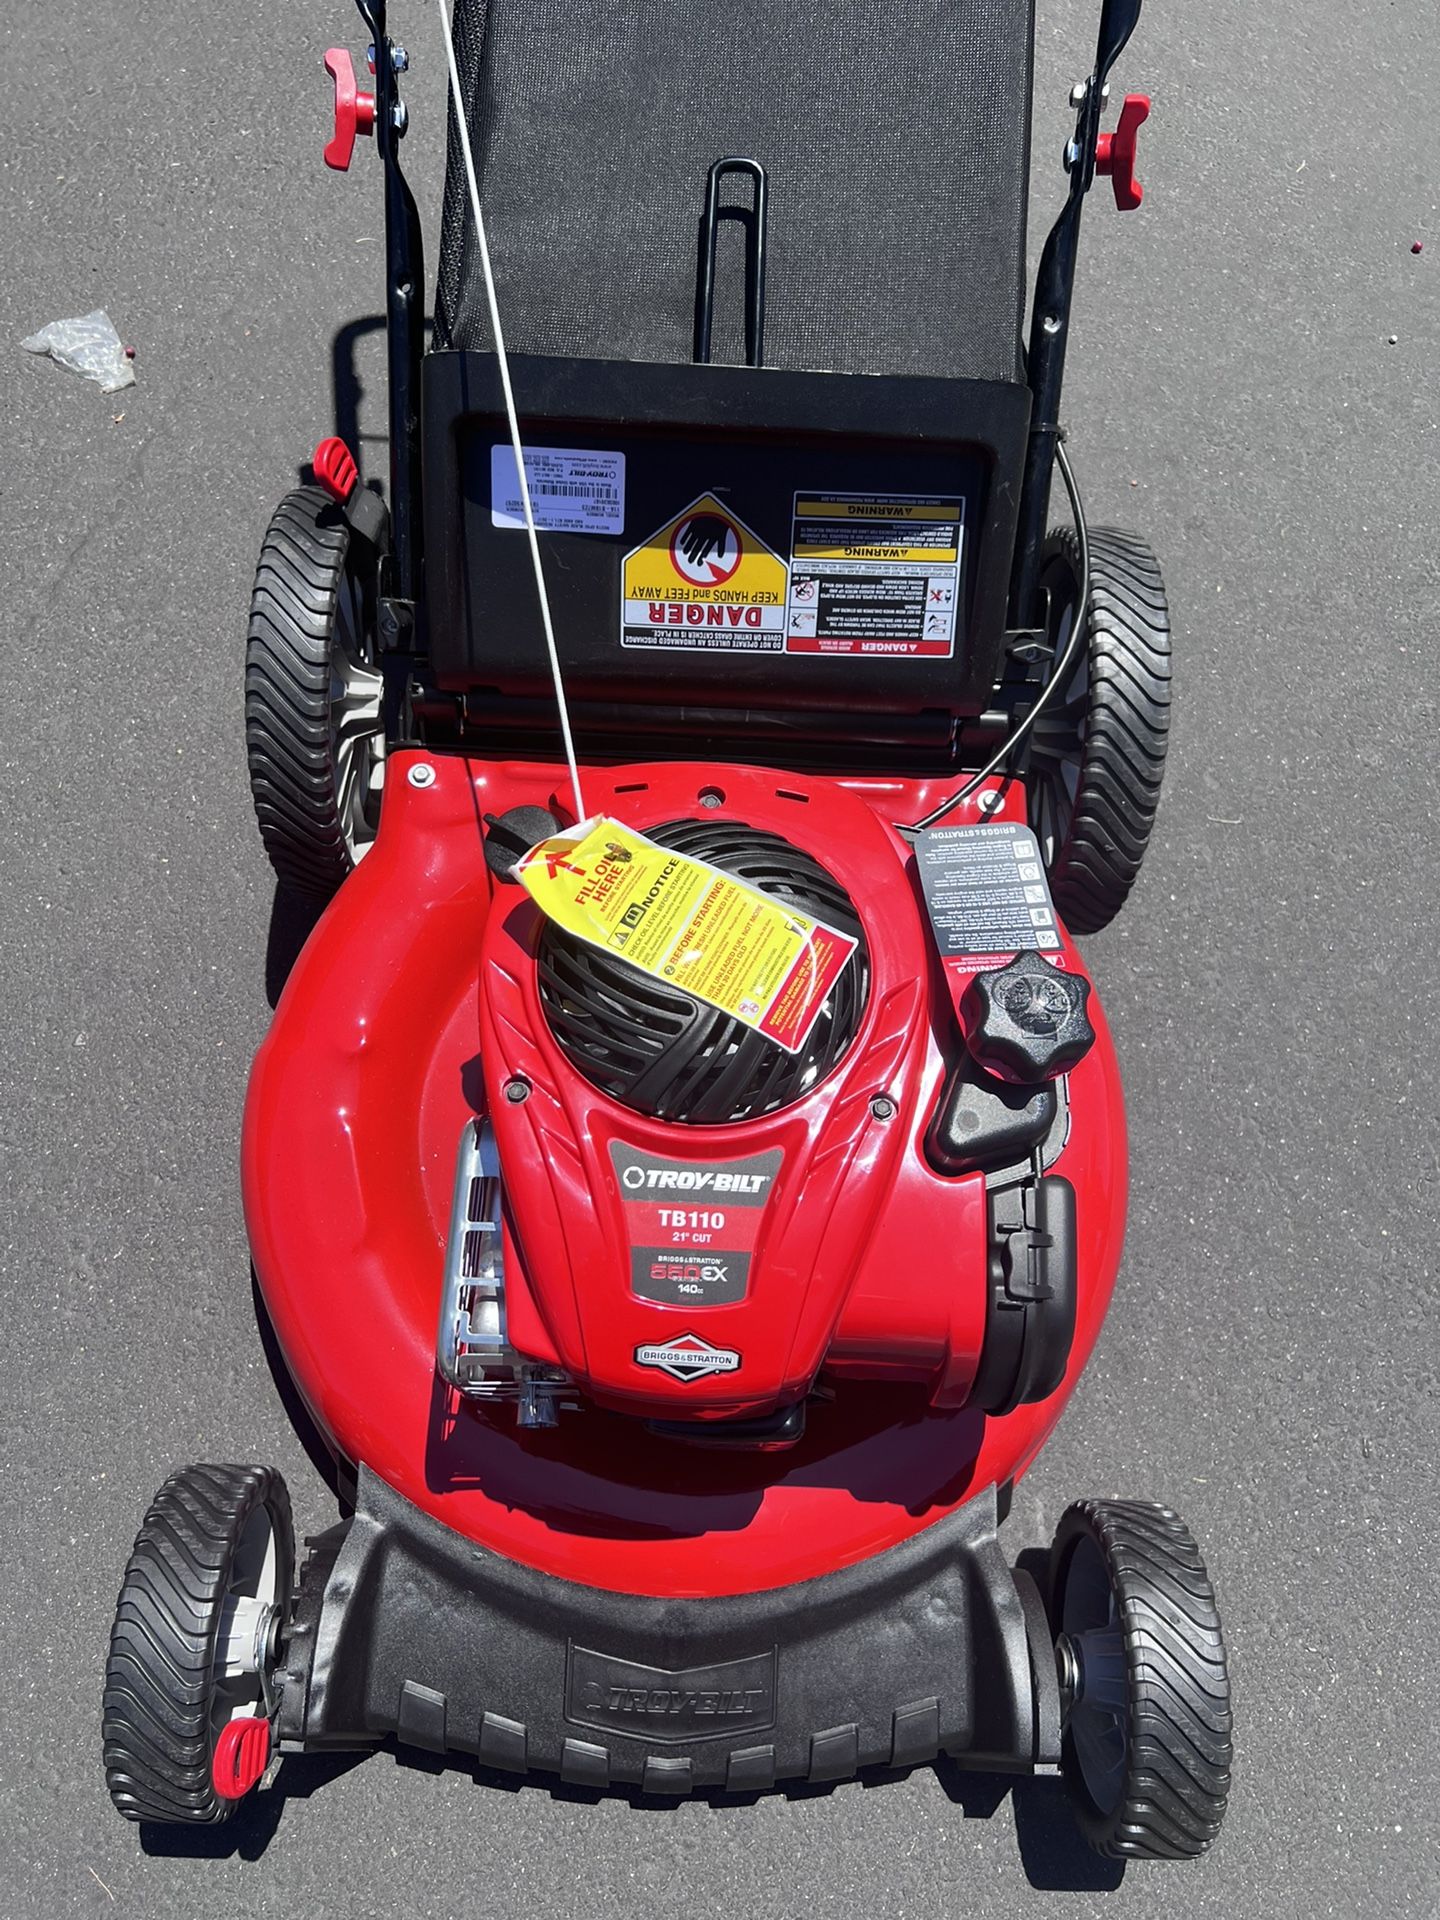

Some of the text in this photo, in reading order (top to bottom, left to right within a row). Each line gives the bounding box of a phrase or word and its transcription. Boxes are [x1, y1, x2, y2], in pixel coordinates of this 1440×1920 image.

[568, 469, 607, 477] TROY-BILT
[848, 505, 903, 515] WARNING
[845, 547, 899, 557] WARNING
[631, 586, 777, 602] KEEP HANDS and FEET AWAY
[649, 603, 762, 627] DANGER
[658, 637, 696, 645] UNDAMAGED
[861, 642, 907, 651] DANGER
[931, 826, 1016, 839] BRIGGS&STRATTON
[573, 849, 618, 906] FILL OIL
[591, 862, 624, 904] HERE
[599, 890, 616, 913] BEFORE
[613, 863, 635, 891] STARTING
[641, 854, 680, 909] NOTICE
[626, 862, 691, 957] CHECK OIL LEVEL BEFORE STARTING
[668, 926, 697, 965] BEFORE
[690, 878, 728, 928] STARTING:
[673, 968, 686, 982] FILL
[703, 900, 728, 934] UNLEADED
[722, 884, 737, 902] FUEL
[704, 983, 717, 998] USE
[711, 950, 737, 985] UNLEADED
[731, 935, 746, 952] FUEL
[741, 921, 753, 936] NOT
[710, 944, 748, 1001] THAN 30 DAYS OLD
[646, 1169, 765, 1192] TROY-BILT
[657, 1209, 725, 1229] TB110
[672, 1232, 712, 1242] 21" CUT
[643, 1351, 732, 1363] BRIGGS&STRATTON
[608, 1687, 762, 1714] TROY-BILT
